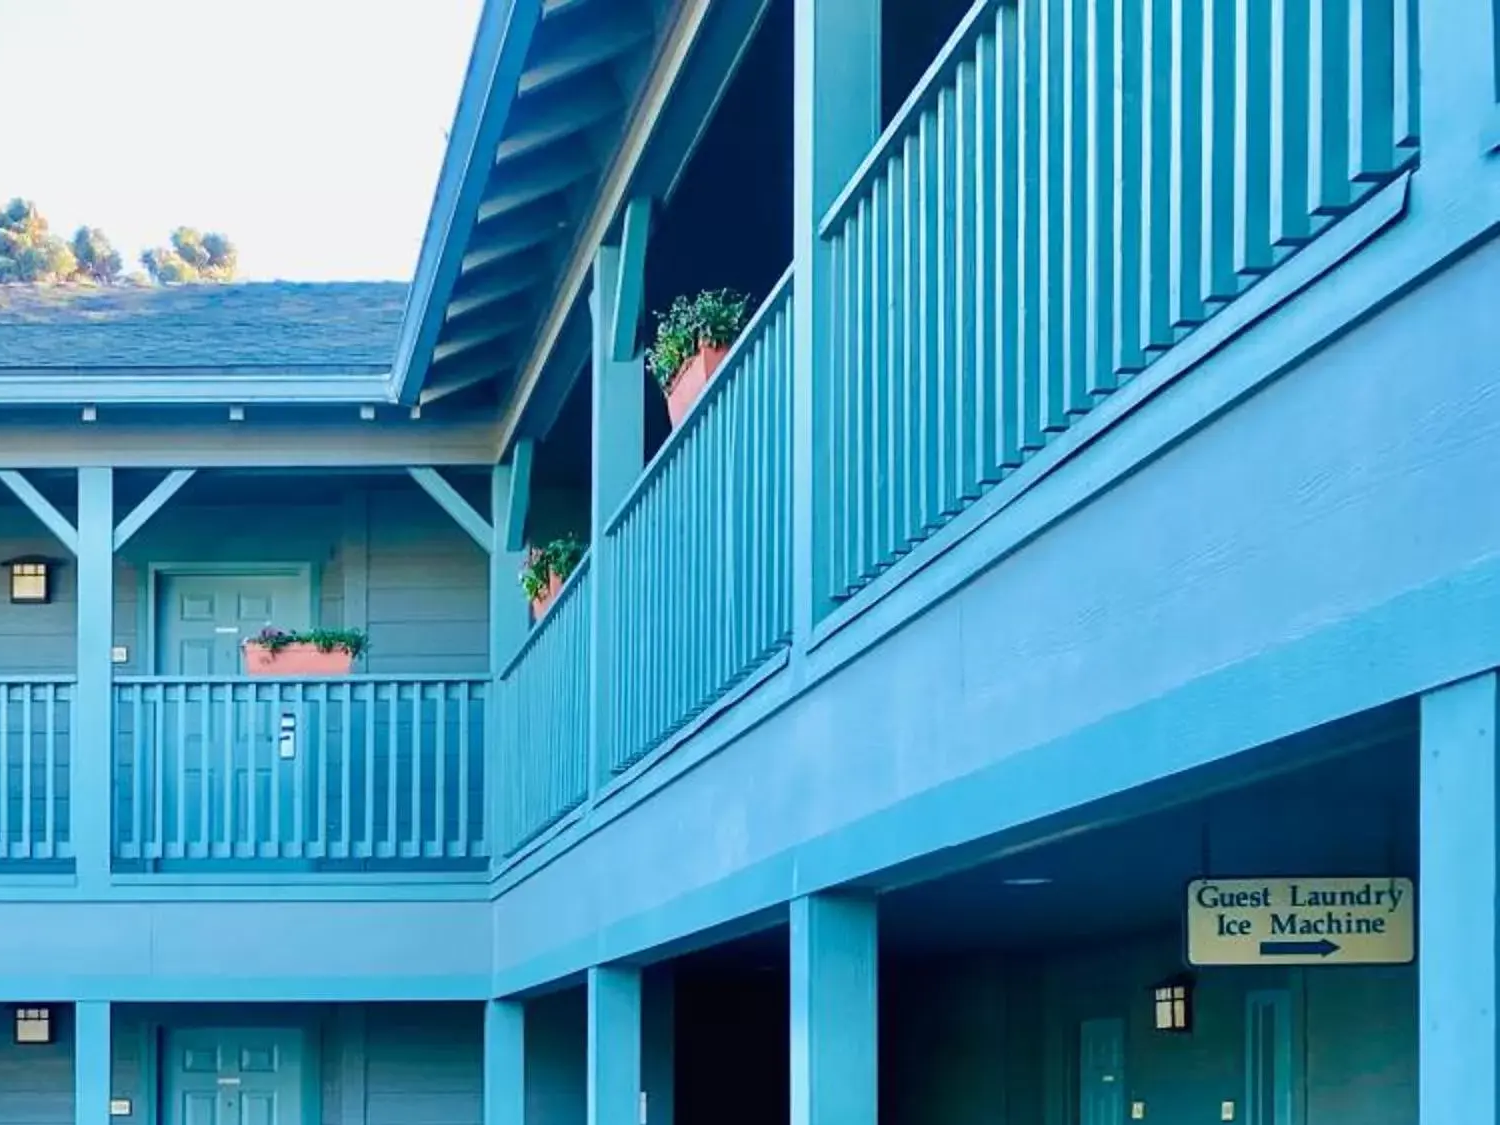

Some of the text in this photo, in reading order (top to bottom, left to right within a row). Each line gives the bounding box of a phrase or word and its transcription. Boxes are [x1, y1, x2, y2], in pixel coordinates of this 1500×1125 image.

[1197, 884, 1403, 913] Guest Laundry
[1217, 912, 1385, 935] Ice Machine
